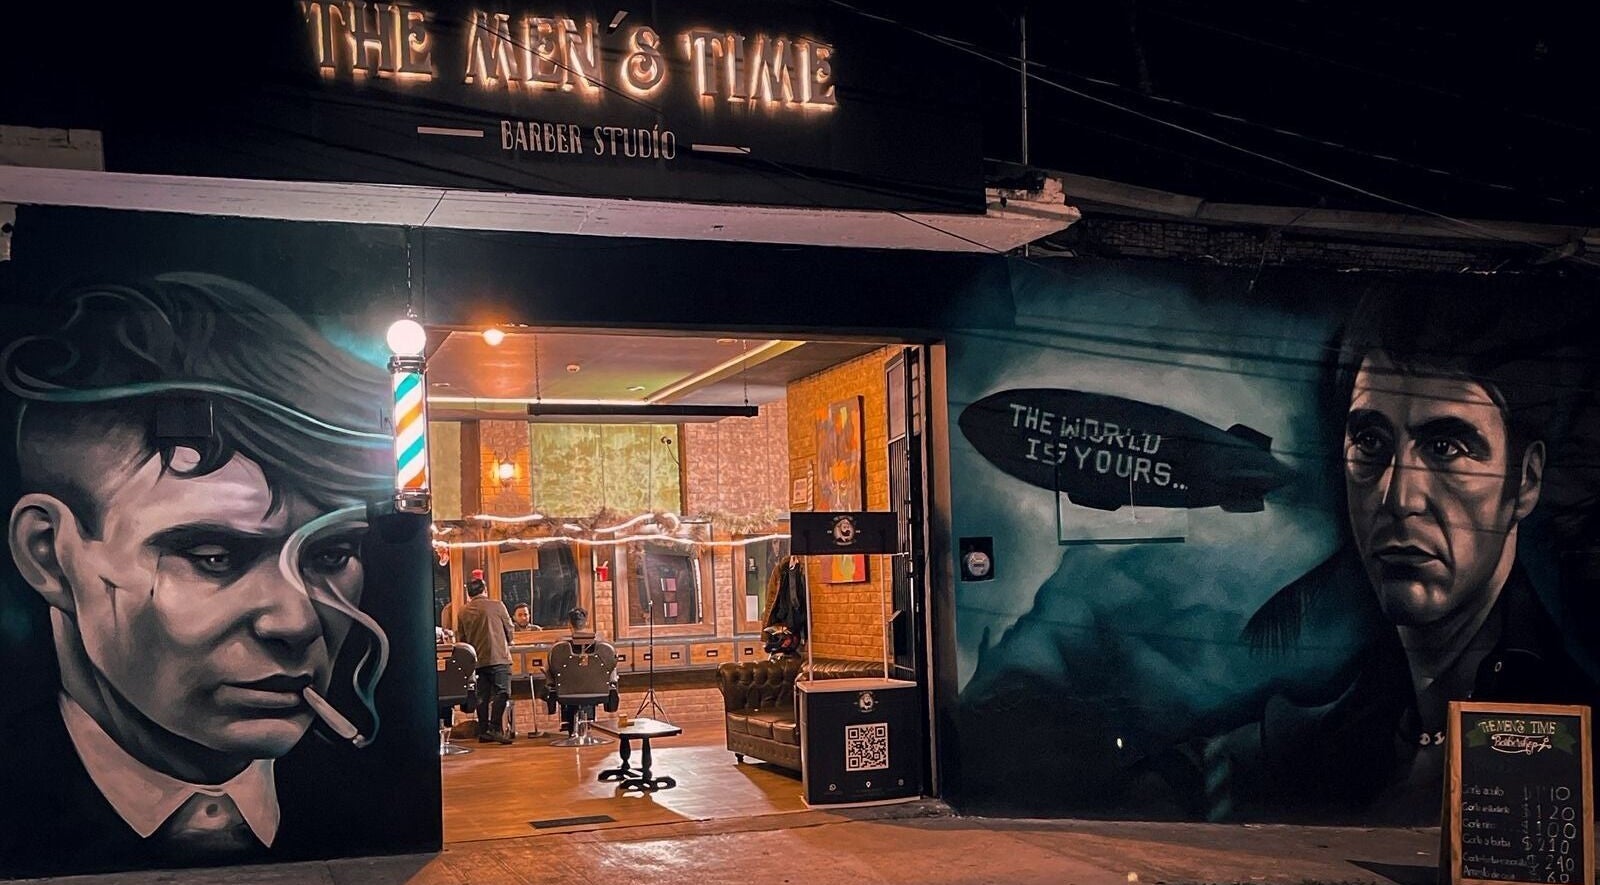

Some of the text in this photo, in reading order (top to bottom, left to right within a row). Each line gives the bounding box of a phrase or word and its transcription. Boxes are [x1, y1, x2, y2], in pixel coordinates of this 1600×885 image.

[304, 0, 433, 79] THE
[682, 28, 837, 109] TIME
[500, 120, 583, 154] BARBER
[1009, 403, 1161, 456] THE WORLD
[1024, 437, 1067, 465] IS
[1530, 720, 1557, 735] TIME
